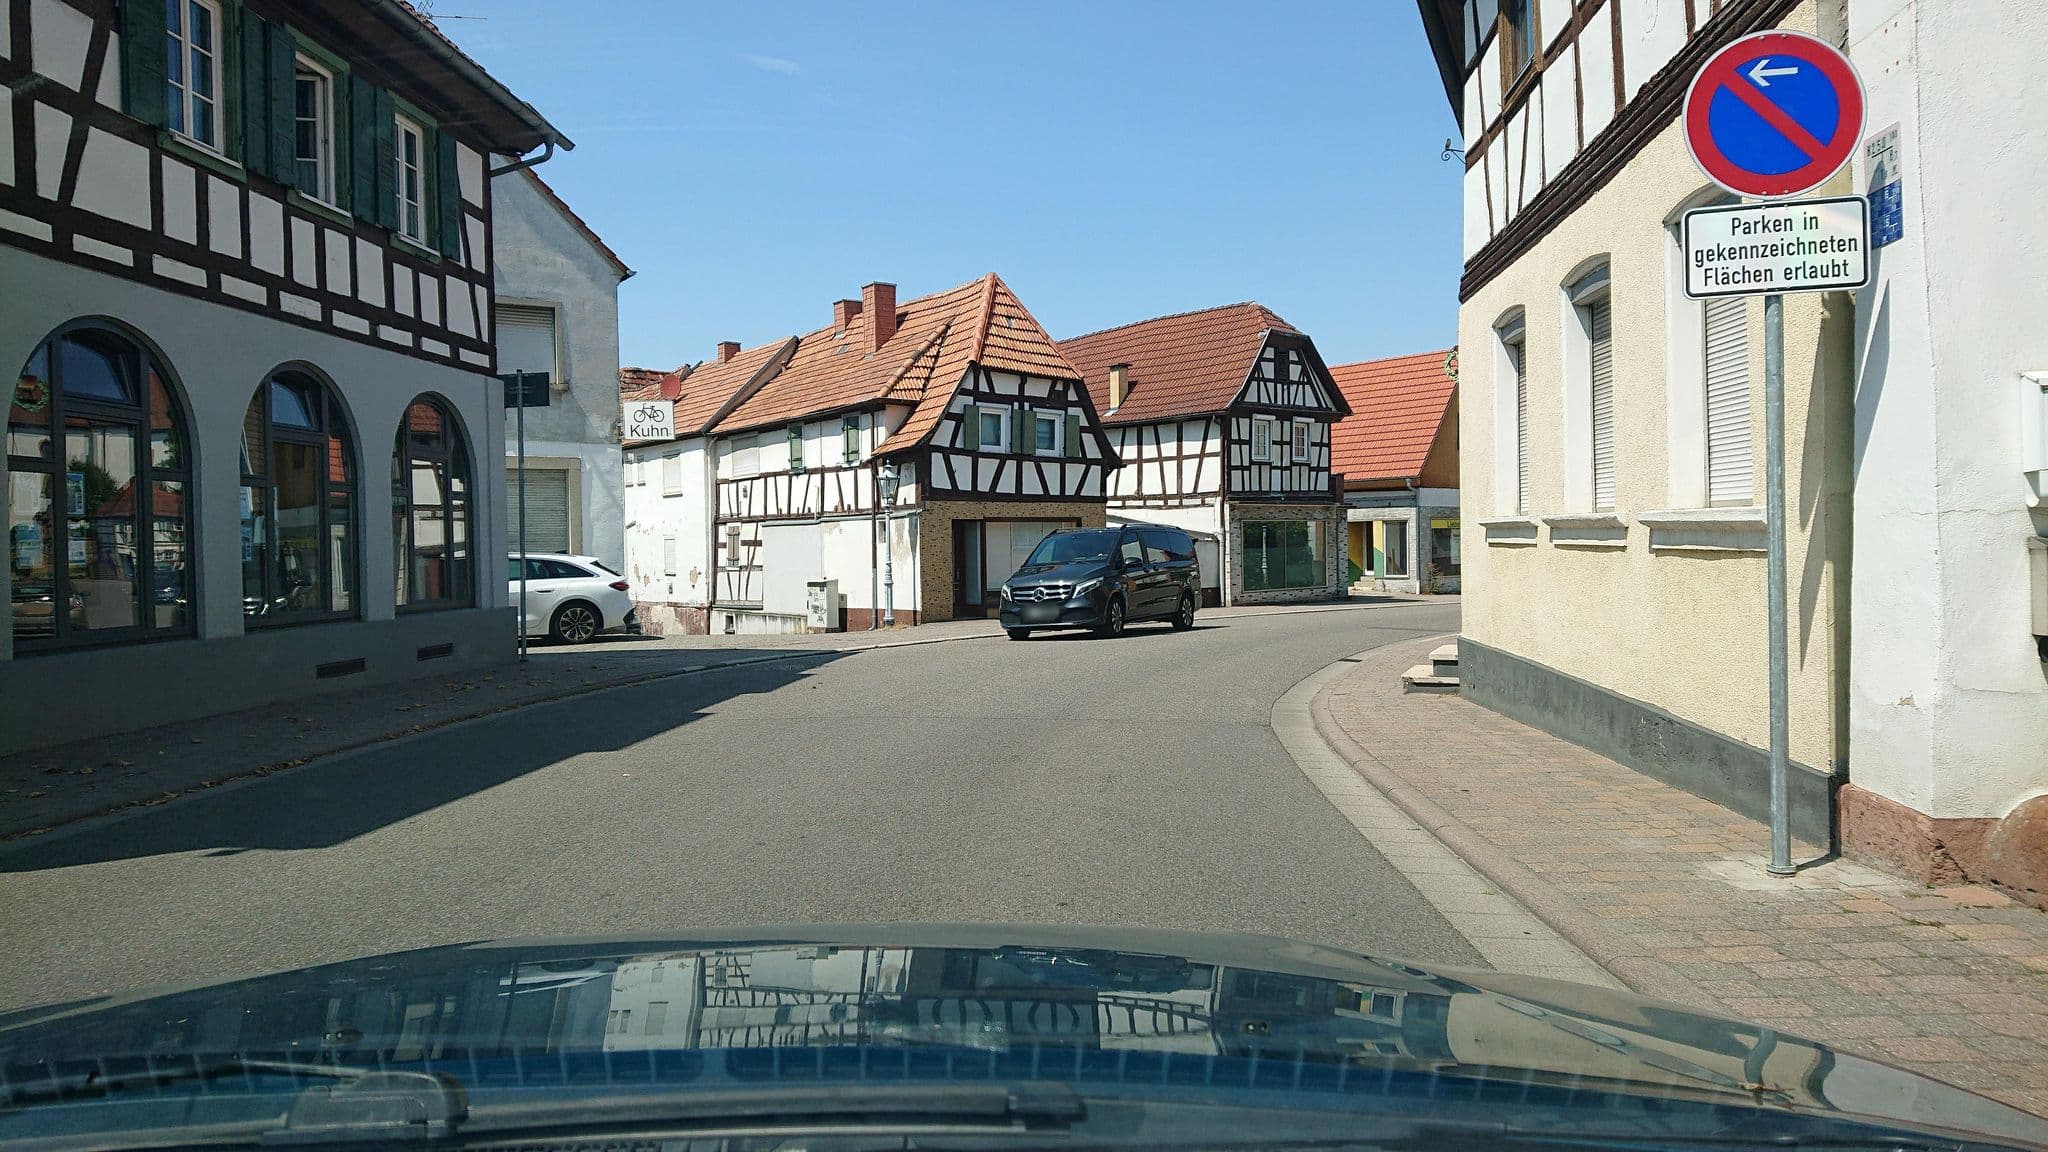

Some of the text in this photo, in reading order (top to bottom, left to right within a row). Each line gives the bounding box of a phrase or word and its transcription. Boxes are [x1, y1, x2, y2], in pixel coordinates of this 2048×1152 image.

[1731, 212, 1819, 236] Parken in
[1695, 235, 1858, 268] gekennzeichneten
[1704, 259, 1849, 287] Flächen erlaubt
[630, 424, 669, 437] Kuhn
